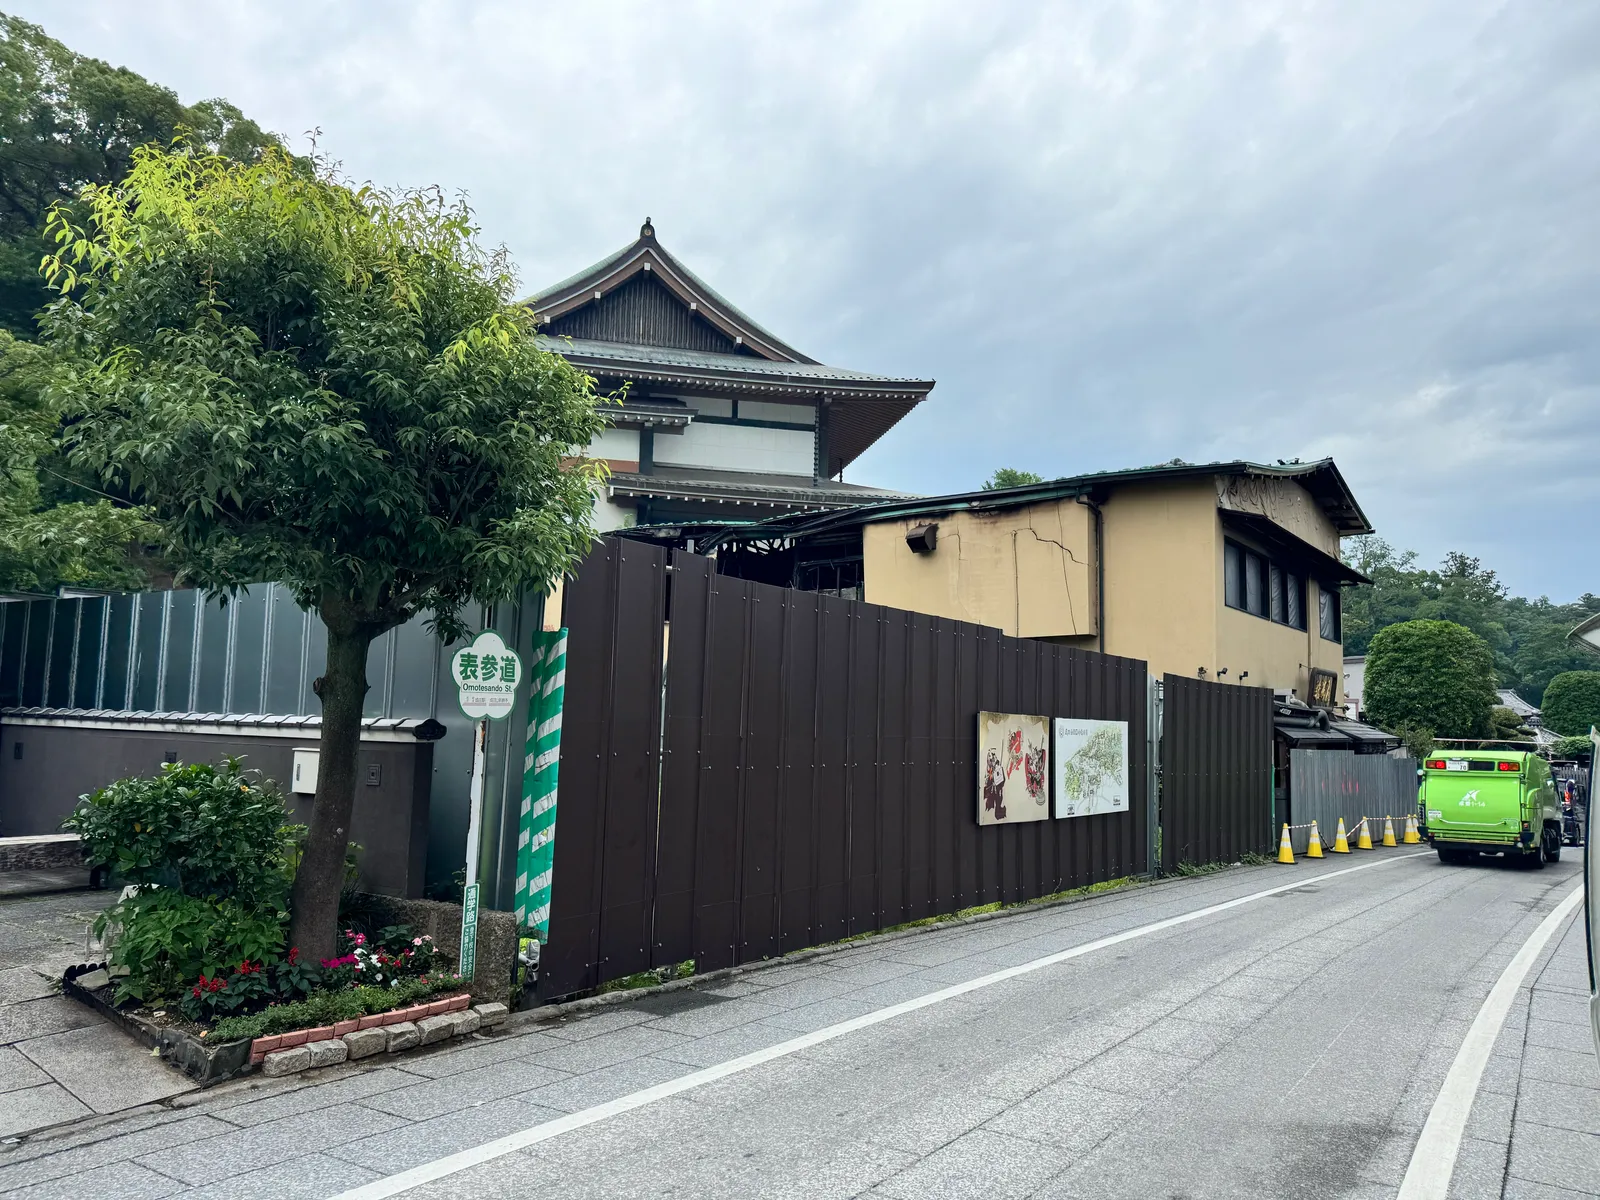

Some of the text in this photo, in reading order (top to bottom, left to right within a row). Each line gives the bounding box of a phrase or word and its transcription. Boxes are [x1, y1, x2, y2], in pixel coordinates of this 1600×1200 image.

[459, 652, 516, 683] 表参道
[463, 683, 513, 692] Omotesando St.
